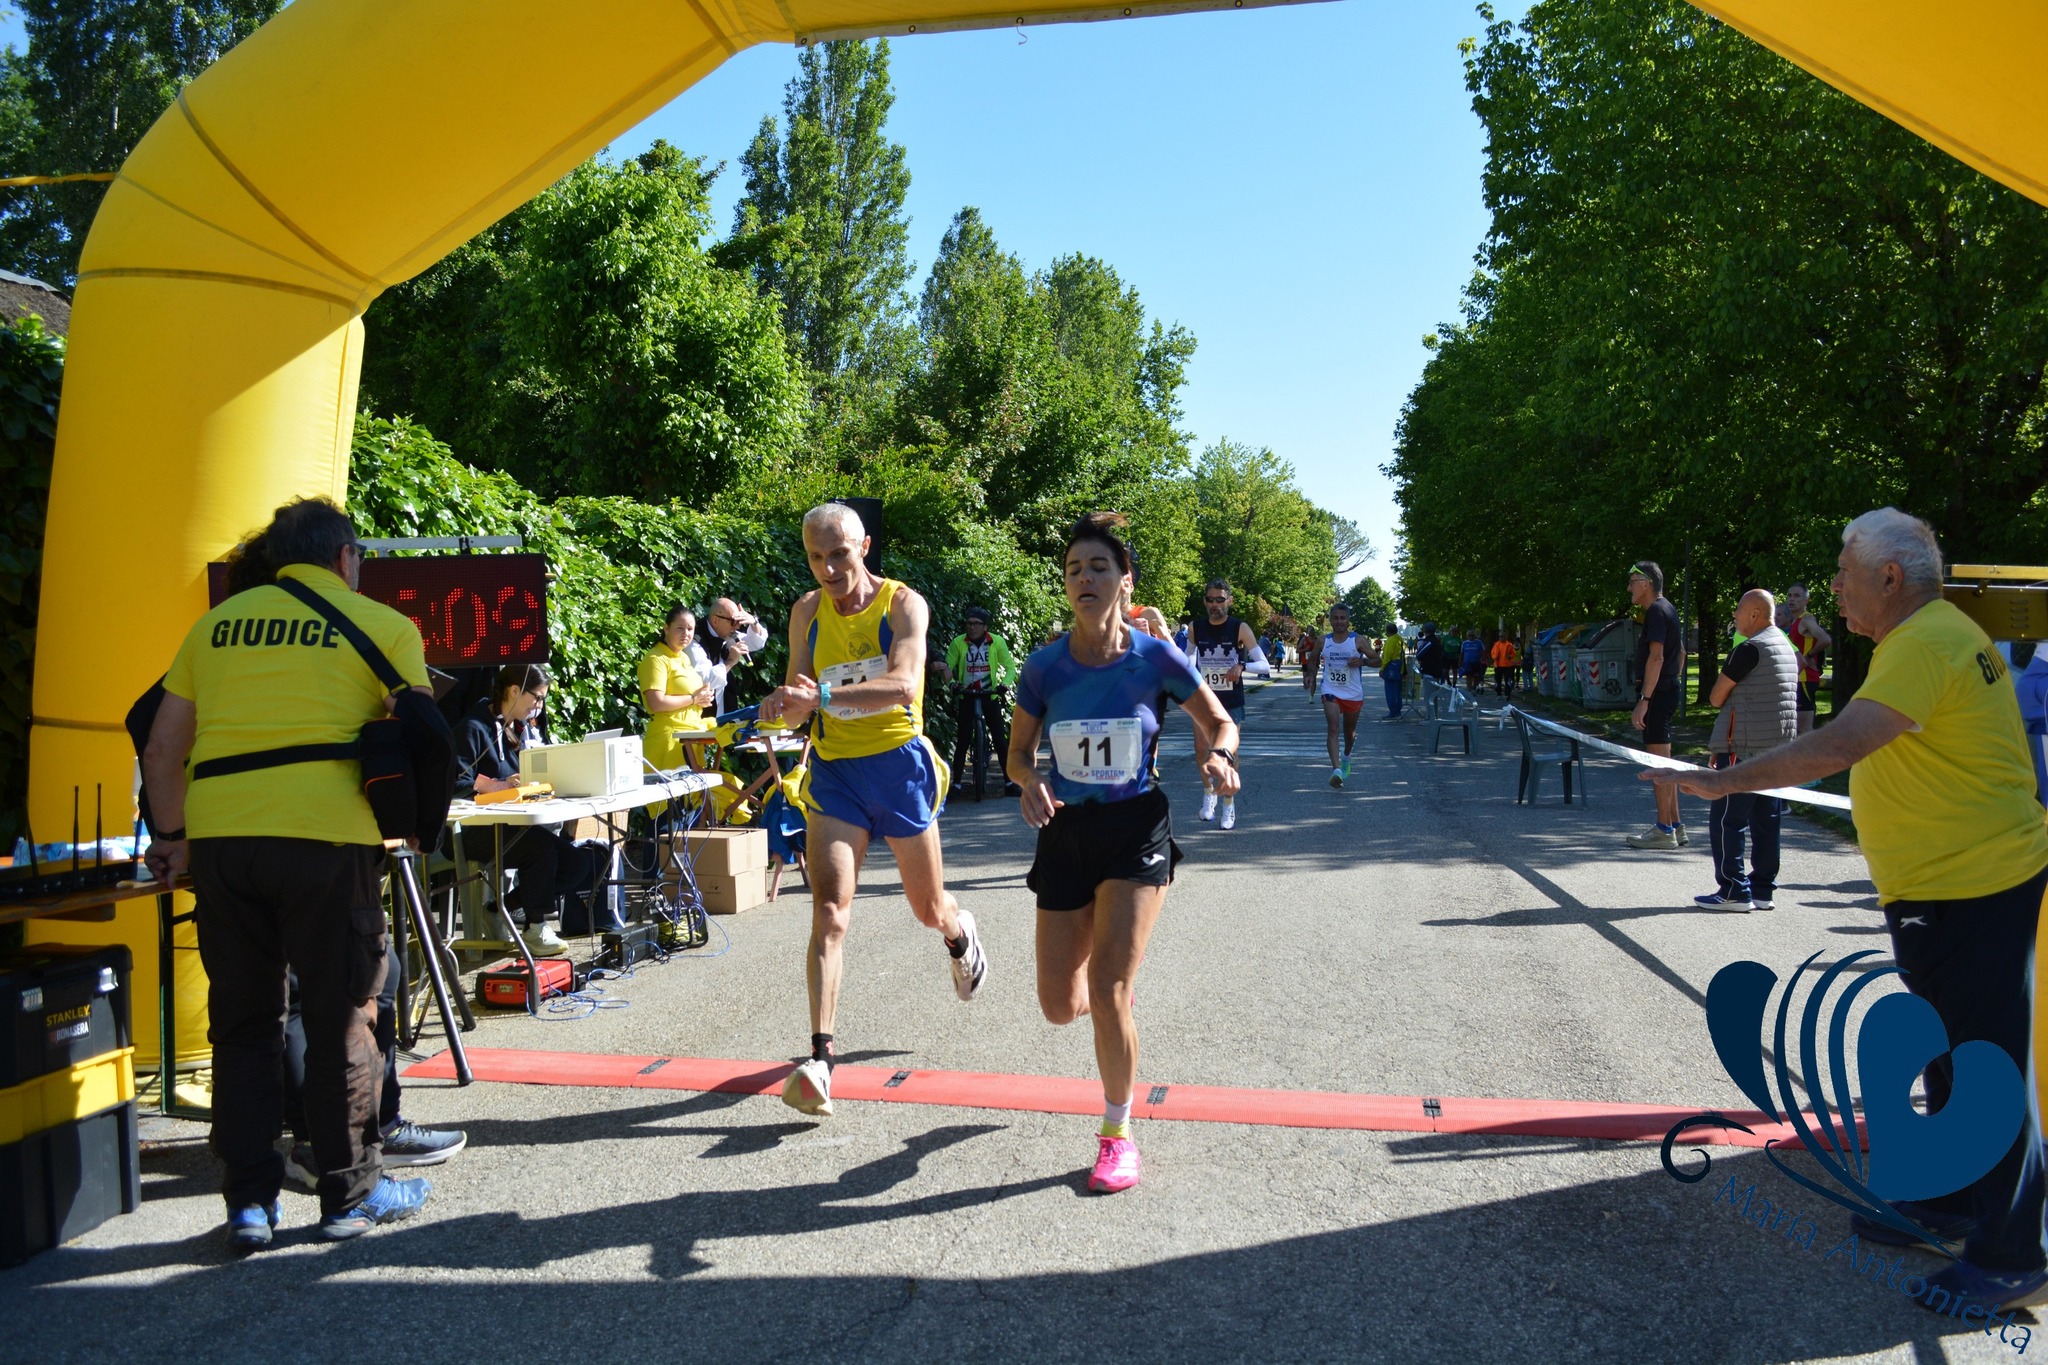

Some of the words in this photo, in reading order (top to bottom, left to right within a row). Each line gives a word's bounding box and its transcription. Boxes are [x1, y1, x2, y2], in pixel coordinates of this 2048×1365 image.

[211, 618, 340, 648] GIUDICE
[1205, 673, 1225, 685] 197
[1330, 672, 1347, 682] 328
[1078, 736, 1111, 767] 11
[46, 1004, 90, 1027] STANLEY
[56, 1021, 89, 1041] BONASERA
